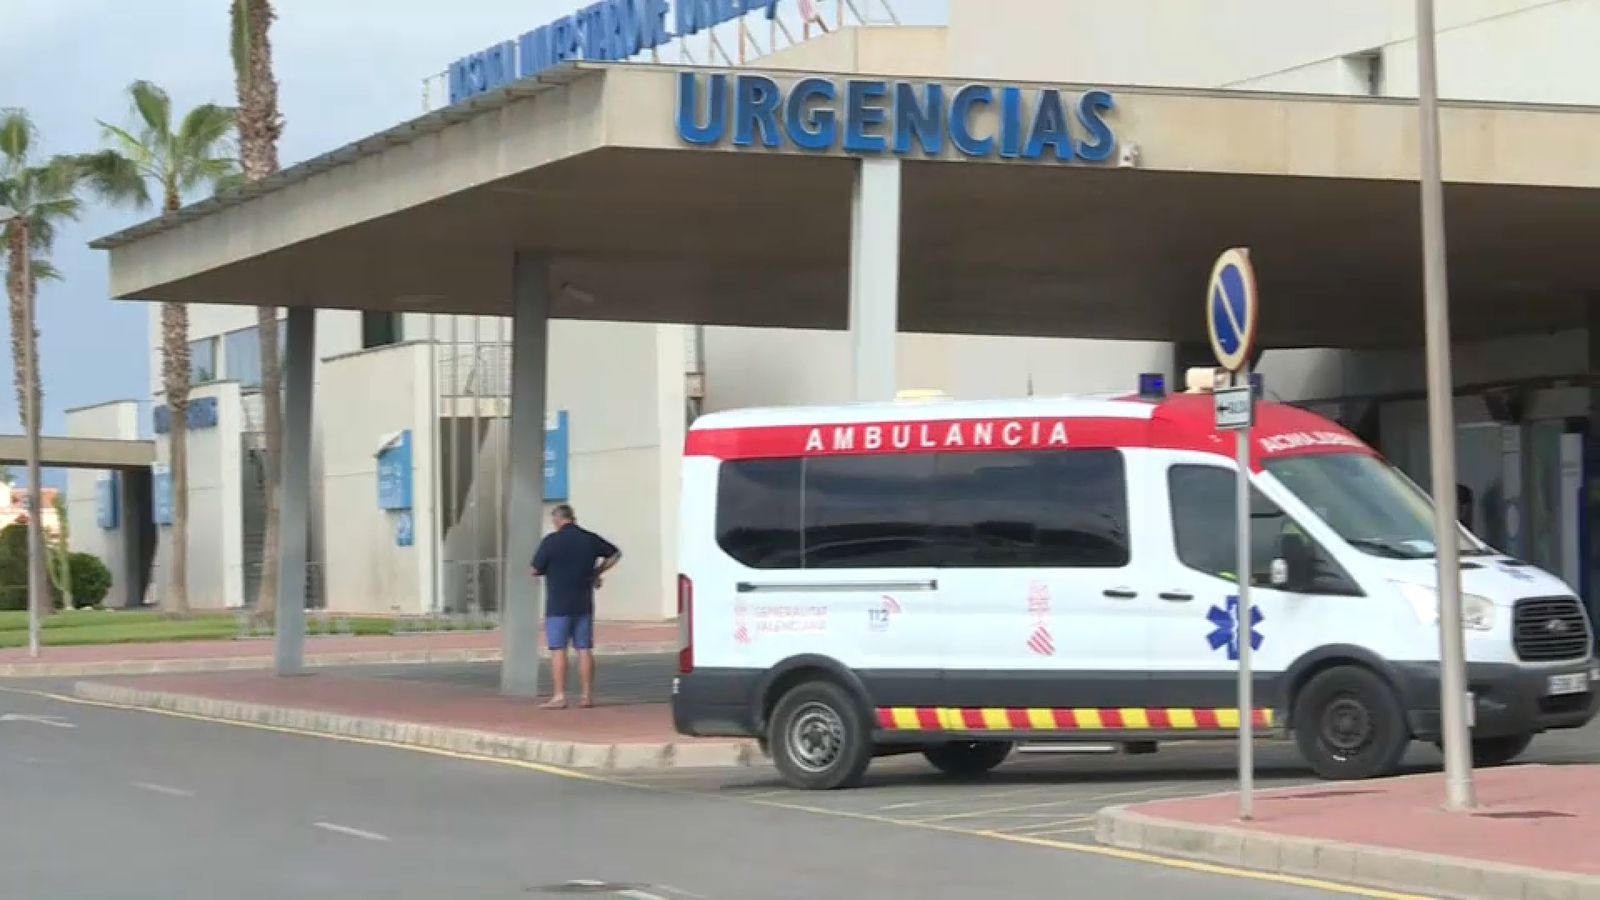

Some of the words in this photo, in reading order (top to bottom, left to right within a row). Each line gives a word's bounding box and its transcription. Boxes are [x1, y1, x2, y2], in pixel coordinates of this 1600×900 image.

[675, 71, 1115, 162] URGENCIAS
[805, 420, 1070, 451] AMBULANCIA
[868, 608, 890, 622] 112
